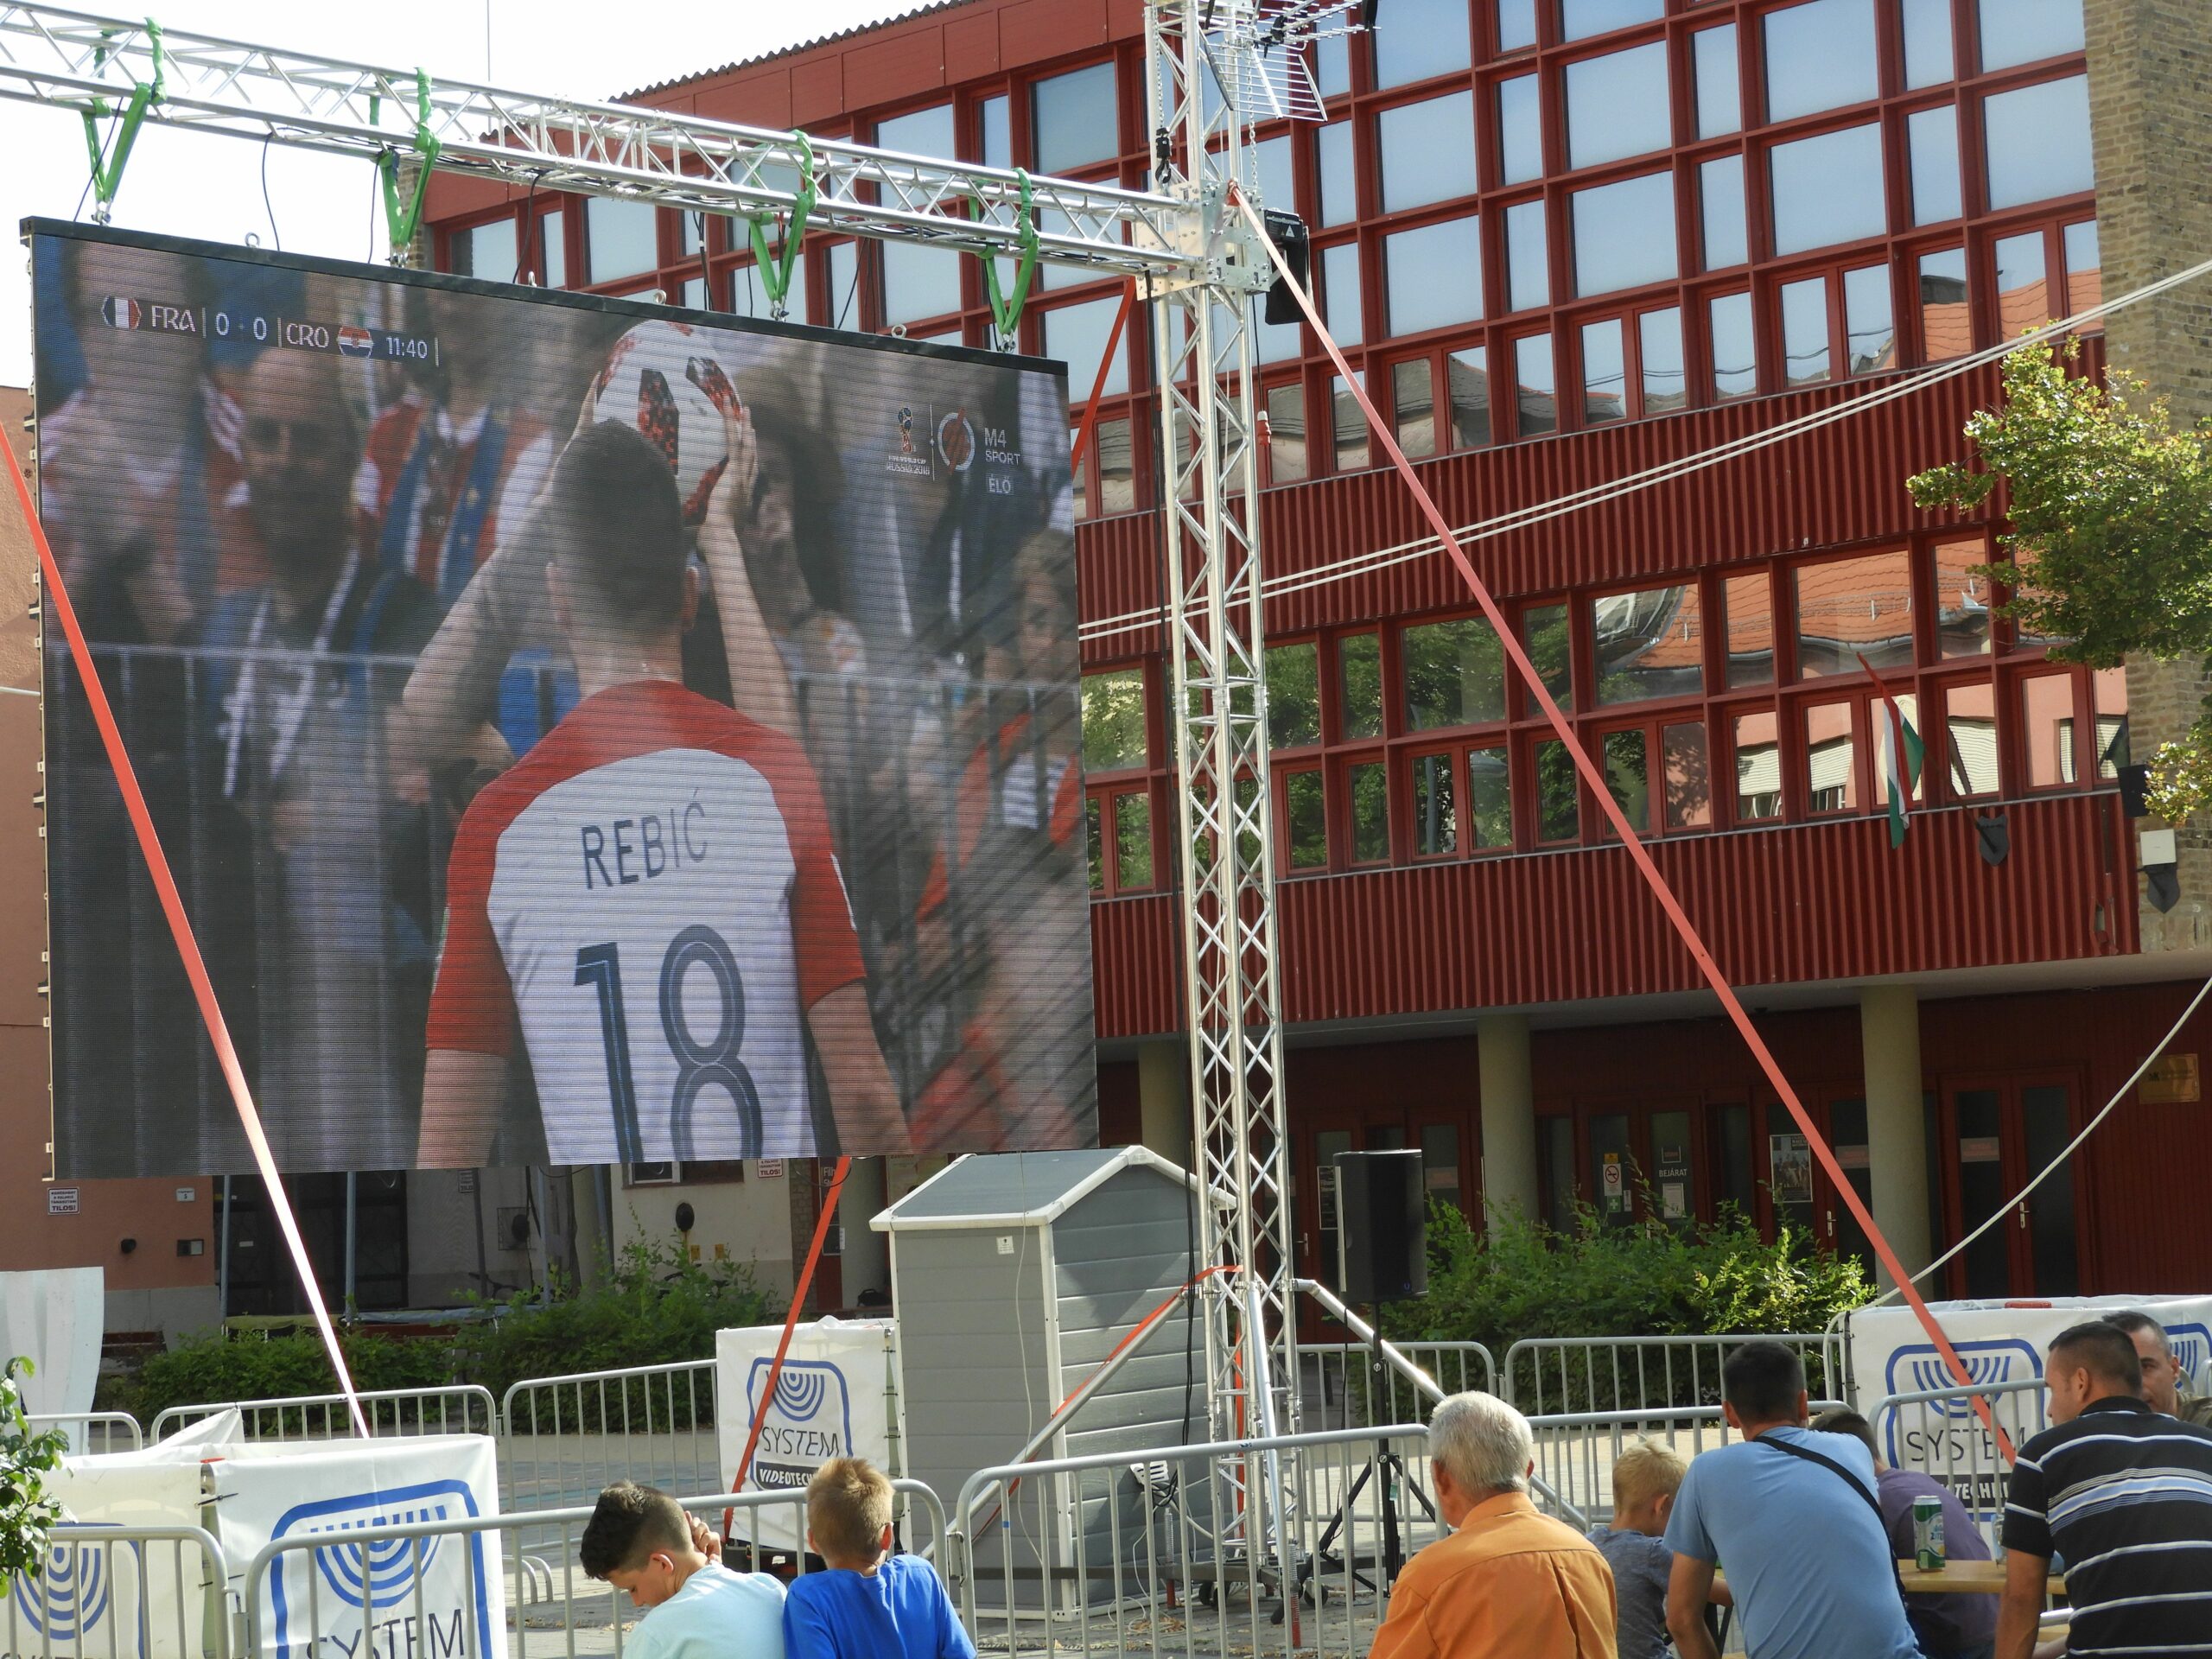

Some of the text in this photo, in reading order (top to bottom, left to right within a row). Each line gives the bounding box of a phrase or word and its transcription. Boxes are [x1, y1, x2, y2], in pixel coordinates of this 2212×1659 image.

[150, 304, 429, 359] FRA 0 0 CRO 11:40
[984, 428, 1007, 448] M4
[985, 449, 1021, 467] SPORT
[581, 787, 708, 890] REBIĆ
[573, 924, 763, 1164] 18
[1659, 1167, 1688, 1178] BEJÁRAT
[761, 1426, 840, 1458] SYSTEM
